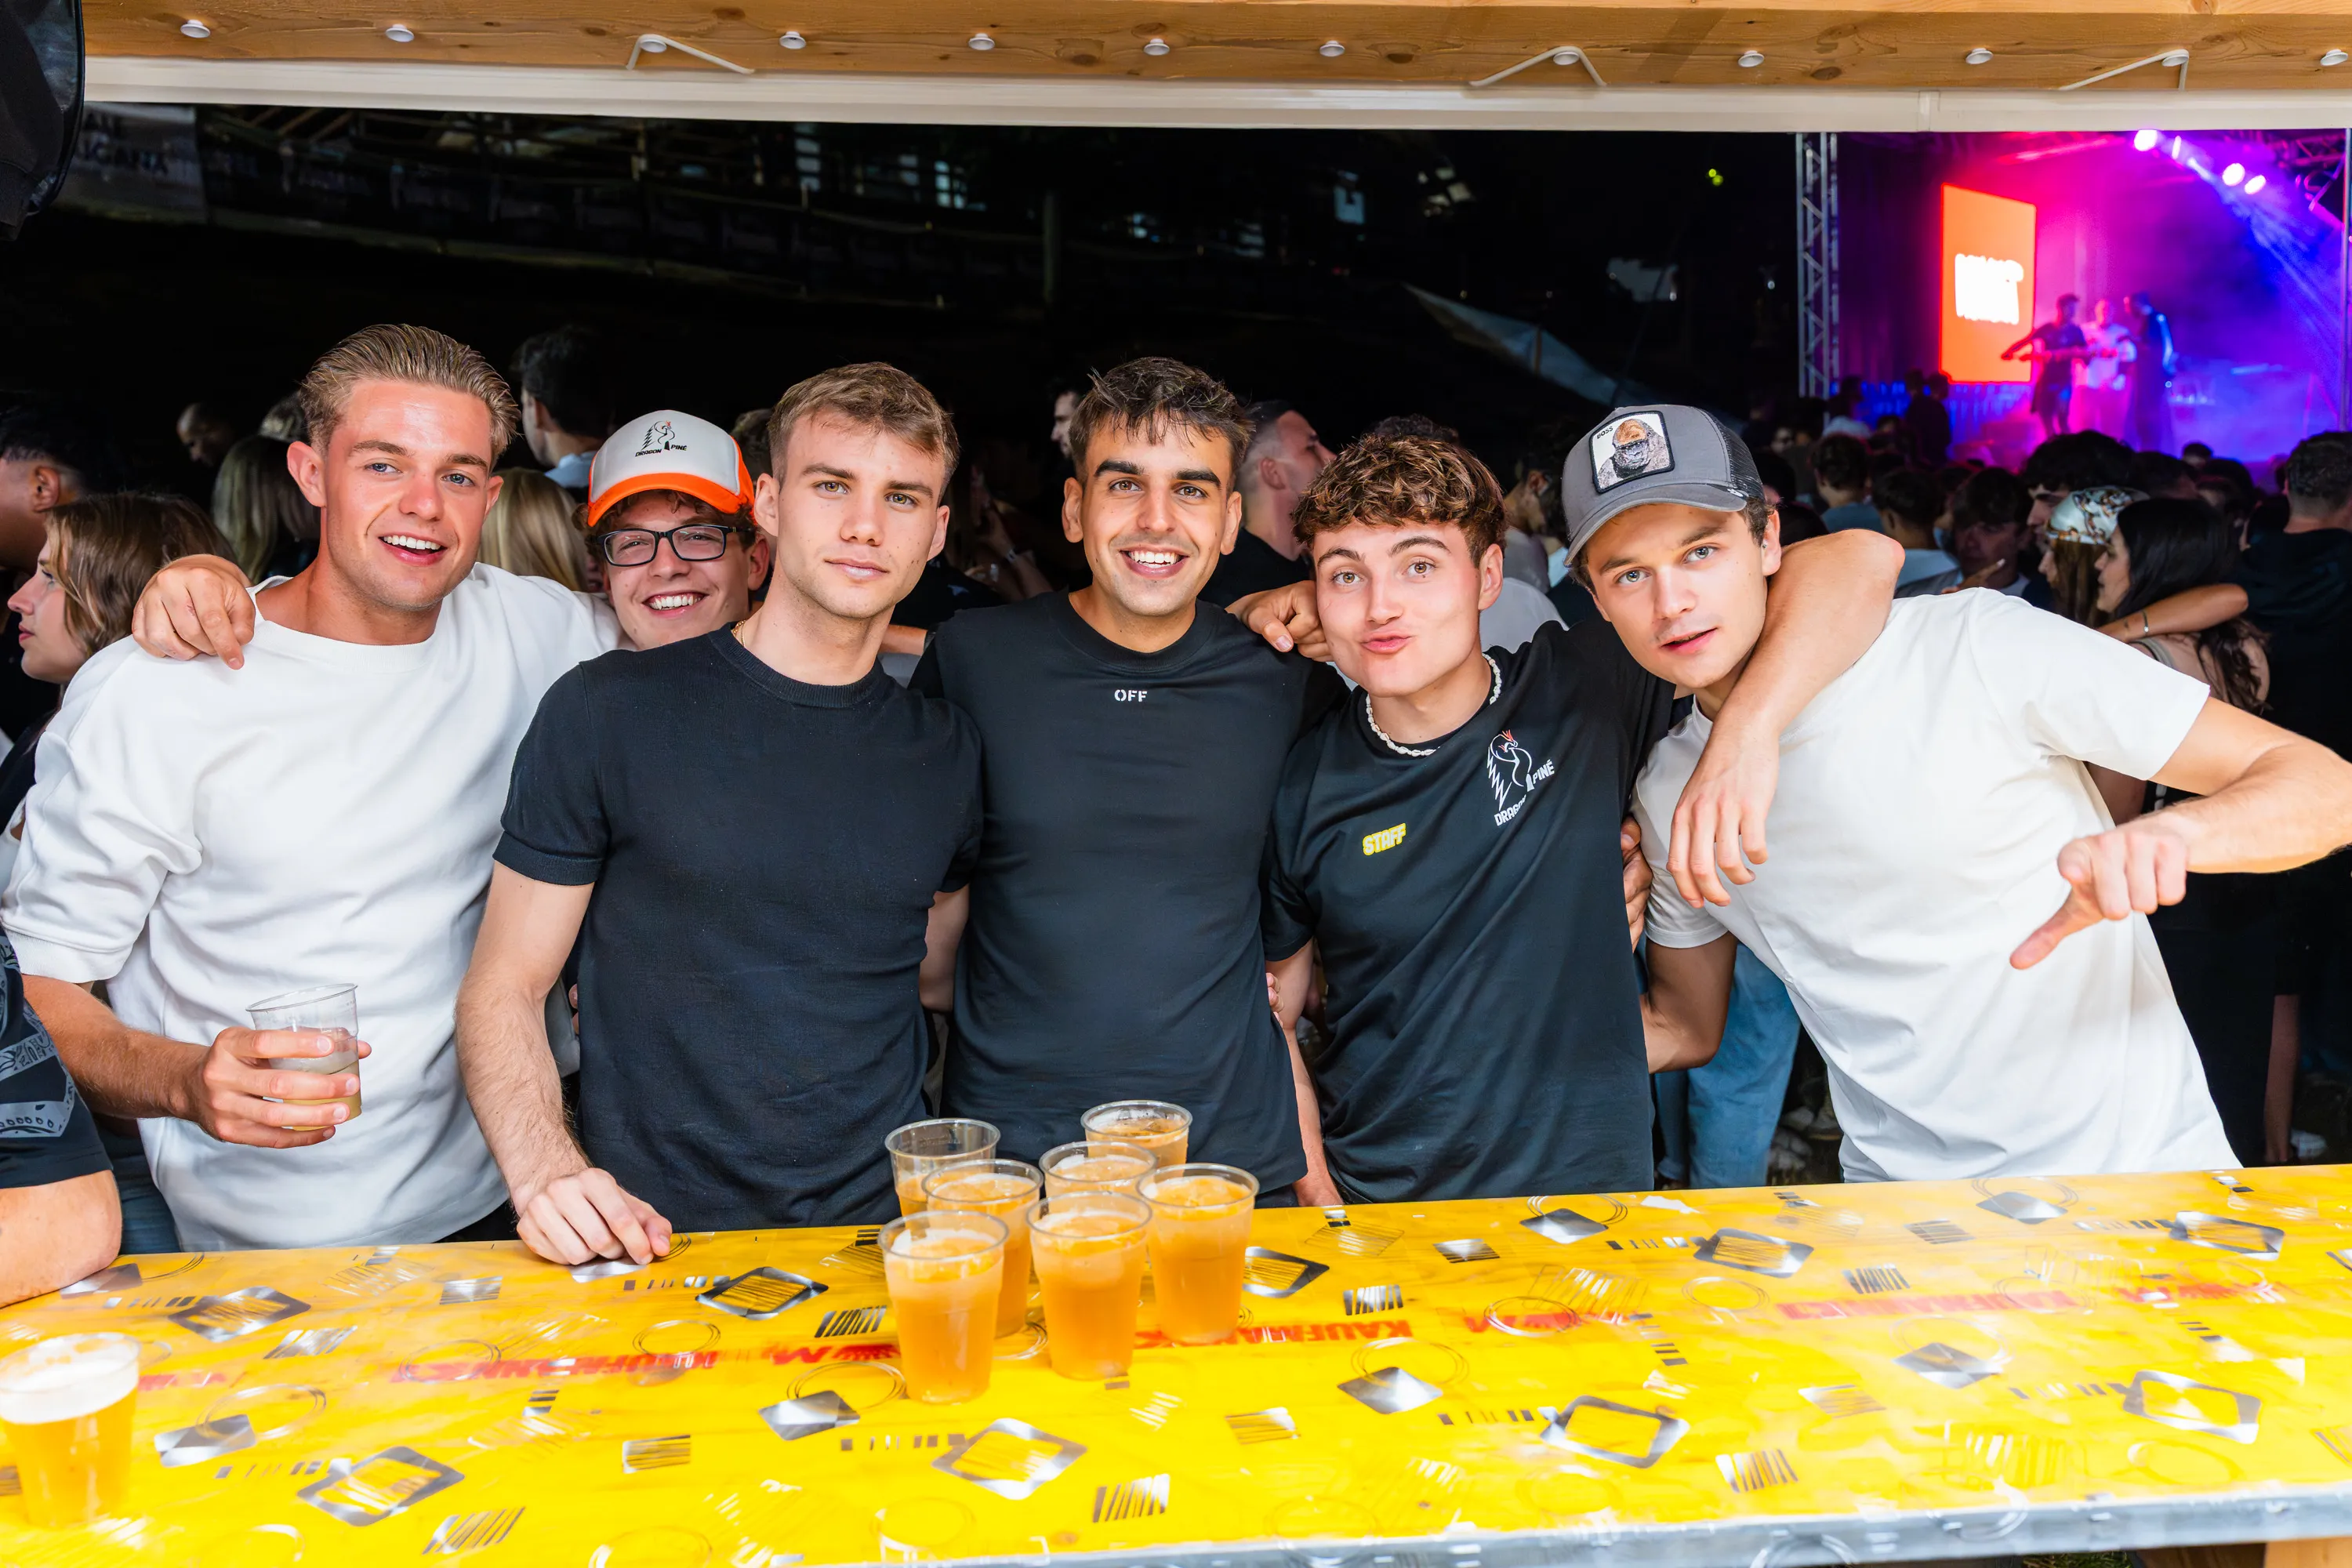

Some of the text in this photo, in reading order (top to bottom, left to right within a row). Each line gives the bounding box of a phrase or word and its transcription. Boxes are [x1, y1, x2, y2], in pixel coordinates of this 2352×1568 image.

[1596, 426, 1613, 439] BOSS
[634, 448, 662, 457] DRAGON
[1114, 689, 1148, 702] OFF
[1532, 758, 1555, 785] PINÉ
[1363, 822, 1406, 856] STAFF
[1179, 1319, 1413, 1348] KAUFMA
